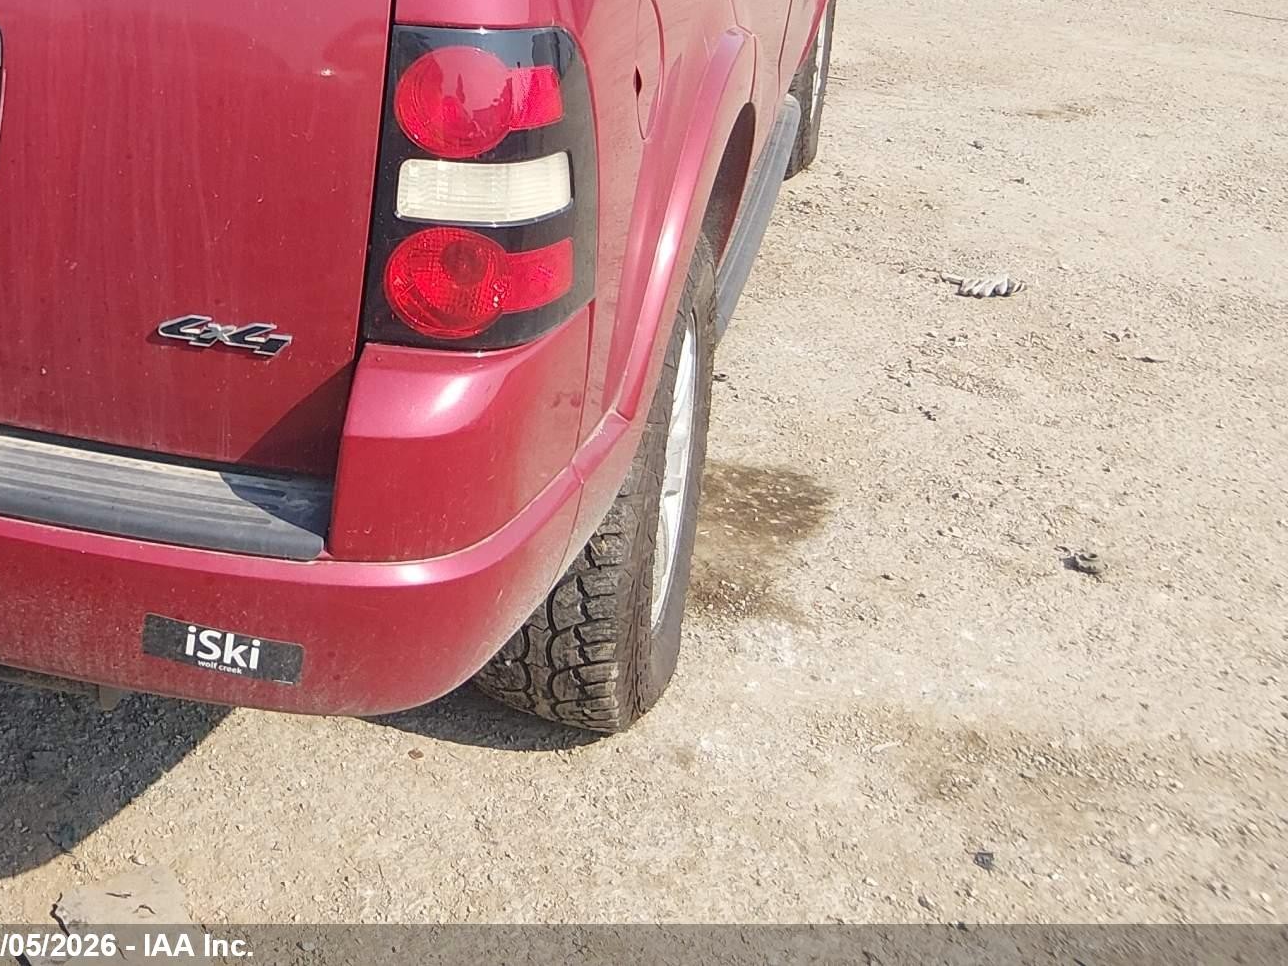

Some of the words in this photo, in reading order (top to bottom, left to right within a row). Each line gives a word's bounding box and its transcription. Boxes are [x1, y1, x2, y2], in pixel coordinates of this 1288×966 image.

[185, 625, 261, 670] iSki
[198, 660, 217, 670] wolf
[219, 664, 242, 675] creek
